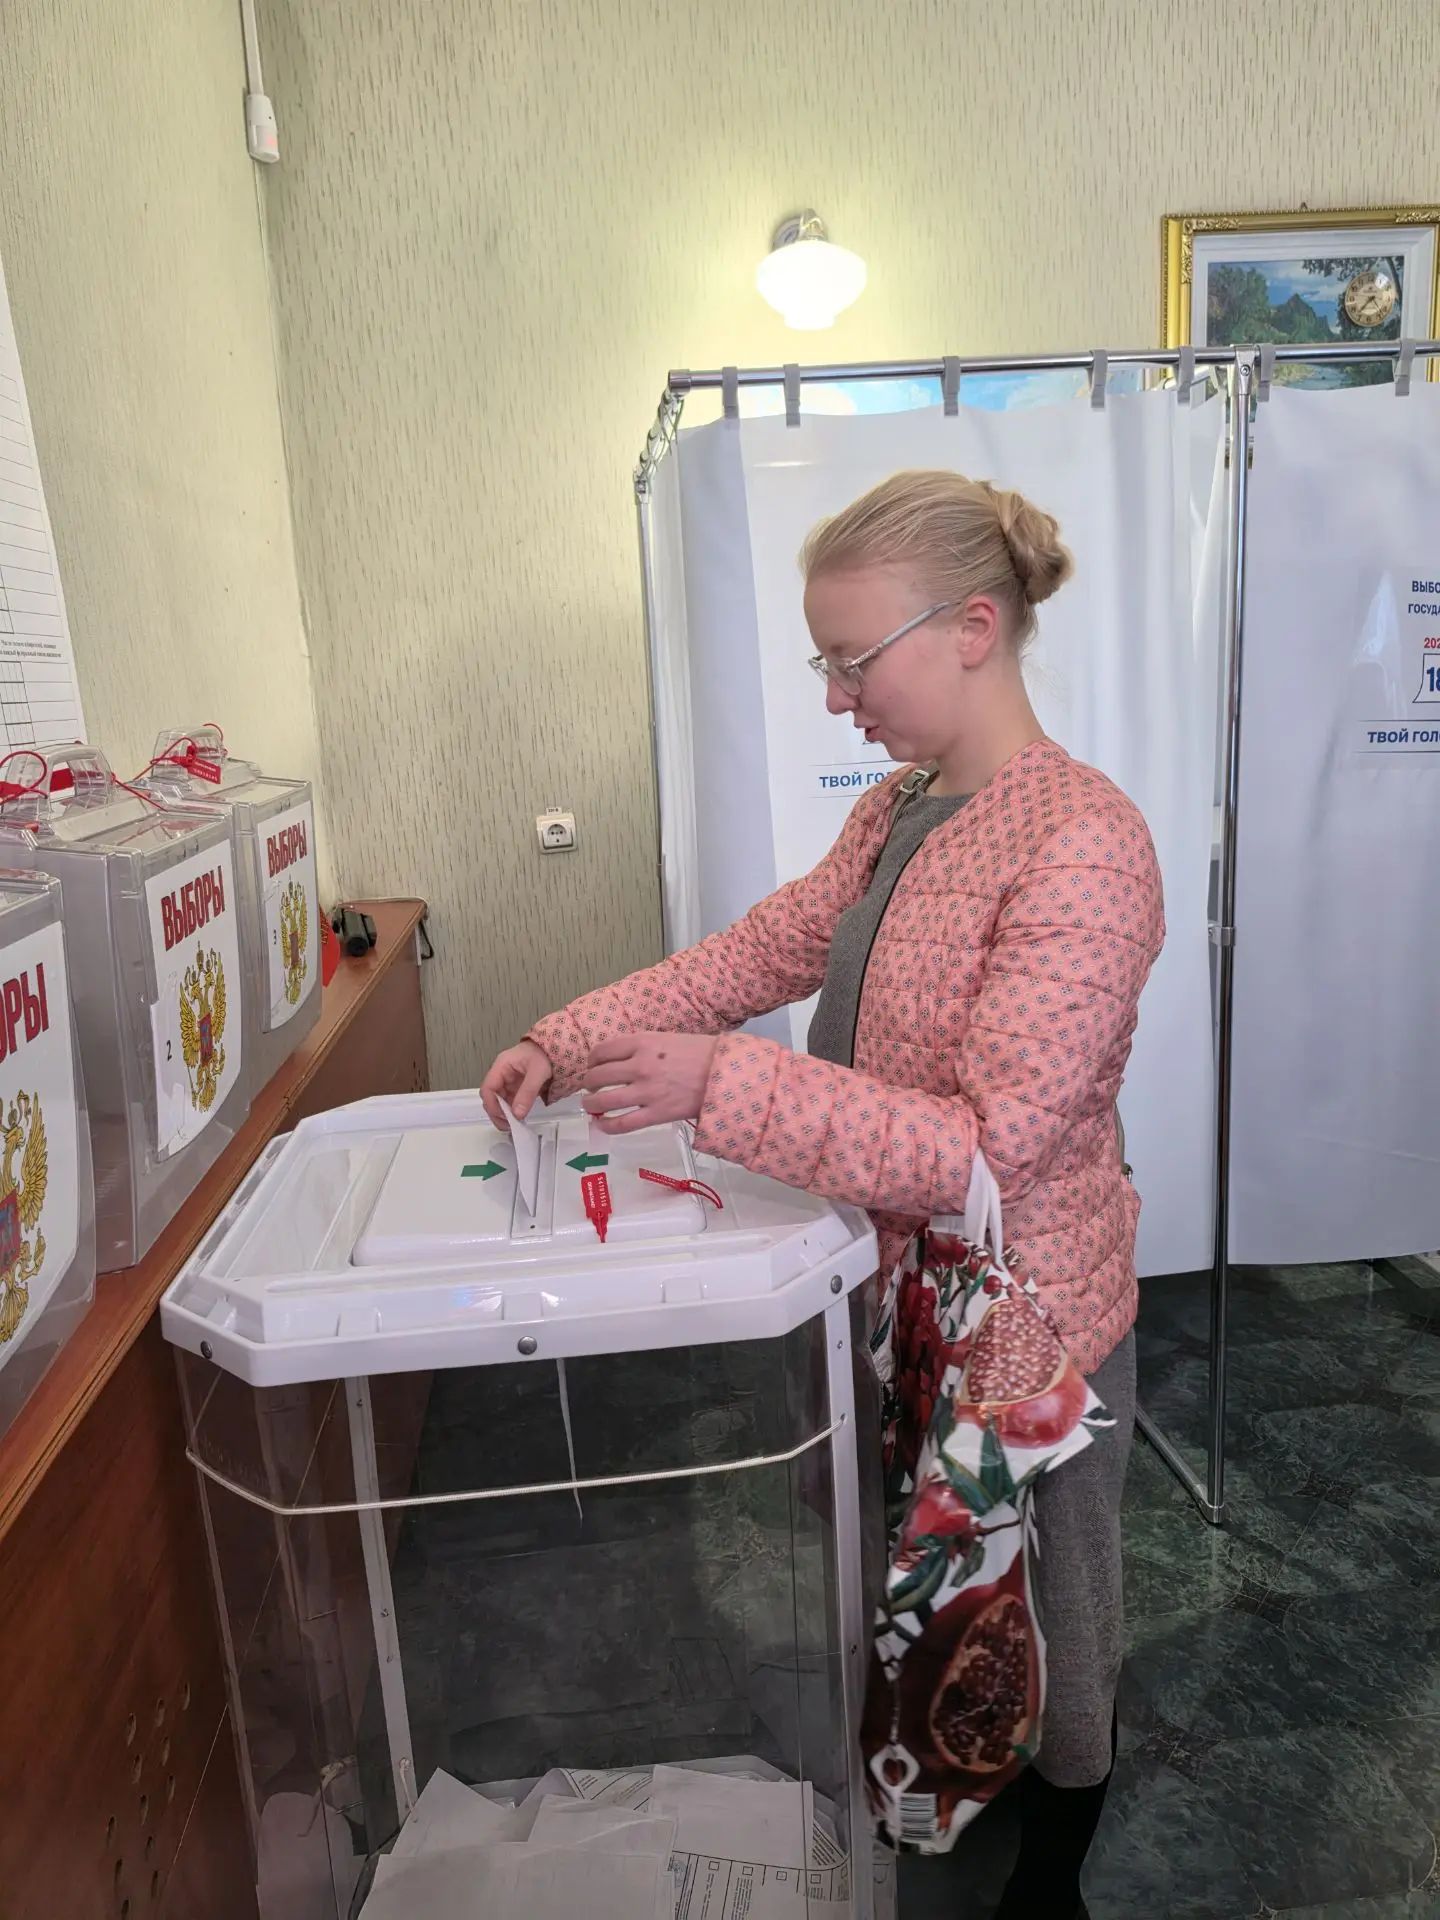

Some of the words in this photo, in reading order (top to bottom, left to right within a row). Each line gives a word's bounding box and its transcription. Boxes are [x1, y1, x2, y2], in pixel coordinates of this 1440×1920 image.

[1411, 580, 1440, 593] ВЫБО
[1367, 727, 1409, 743] ТВОЙ
[1412, 730, 1440, 743] ГОЛ
[819, 771, 862, 788] ТВОЙ
[266, 819, 307, 878] ВЫБОРЫ
[160, 864, 225, 952] ВЫБОРЫ
